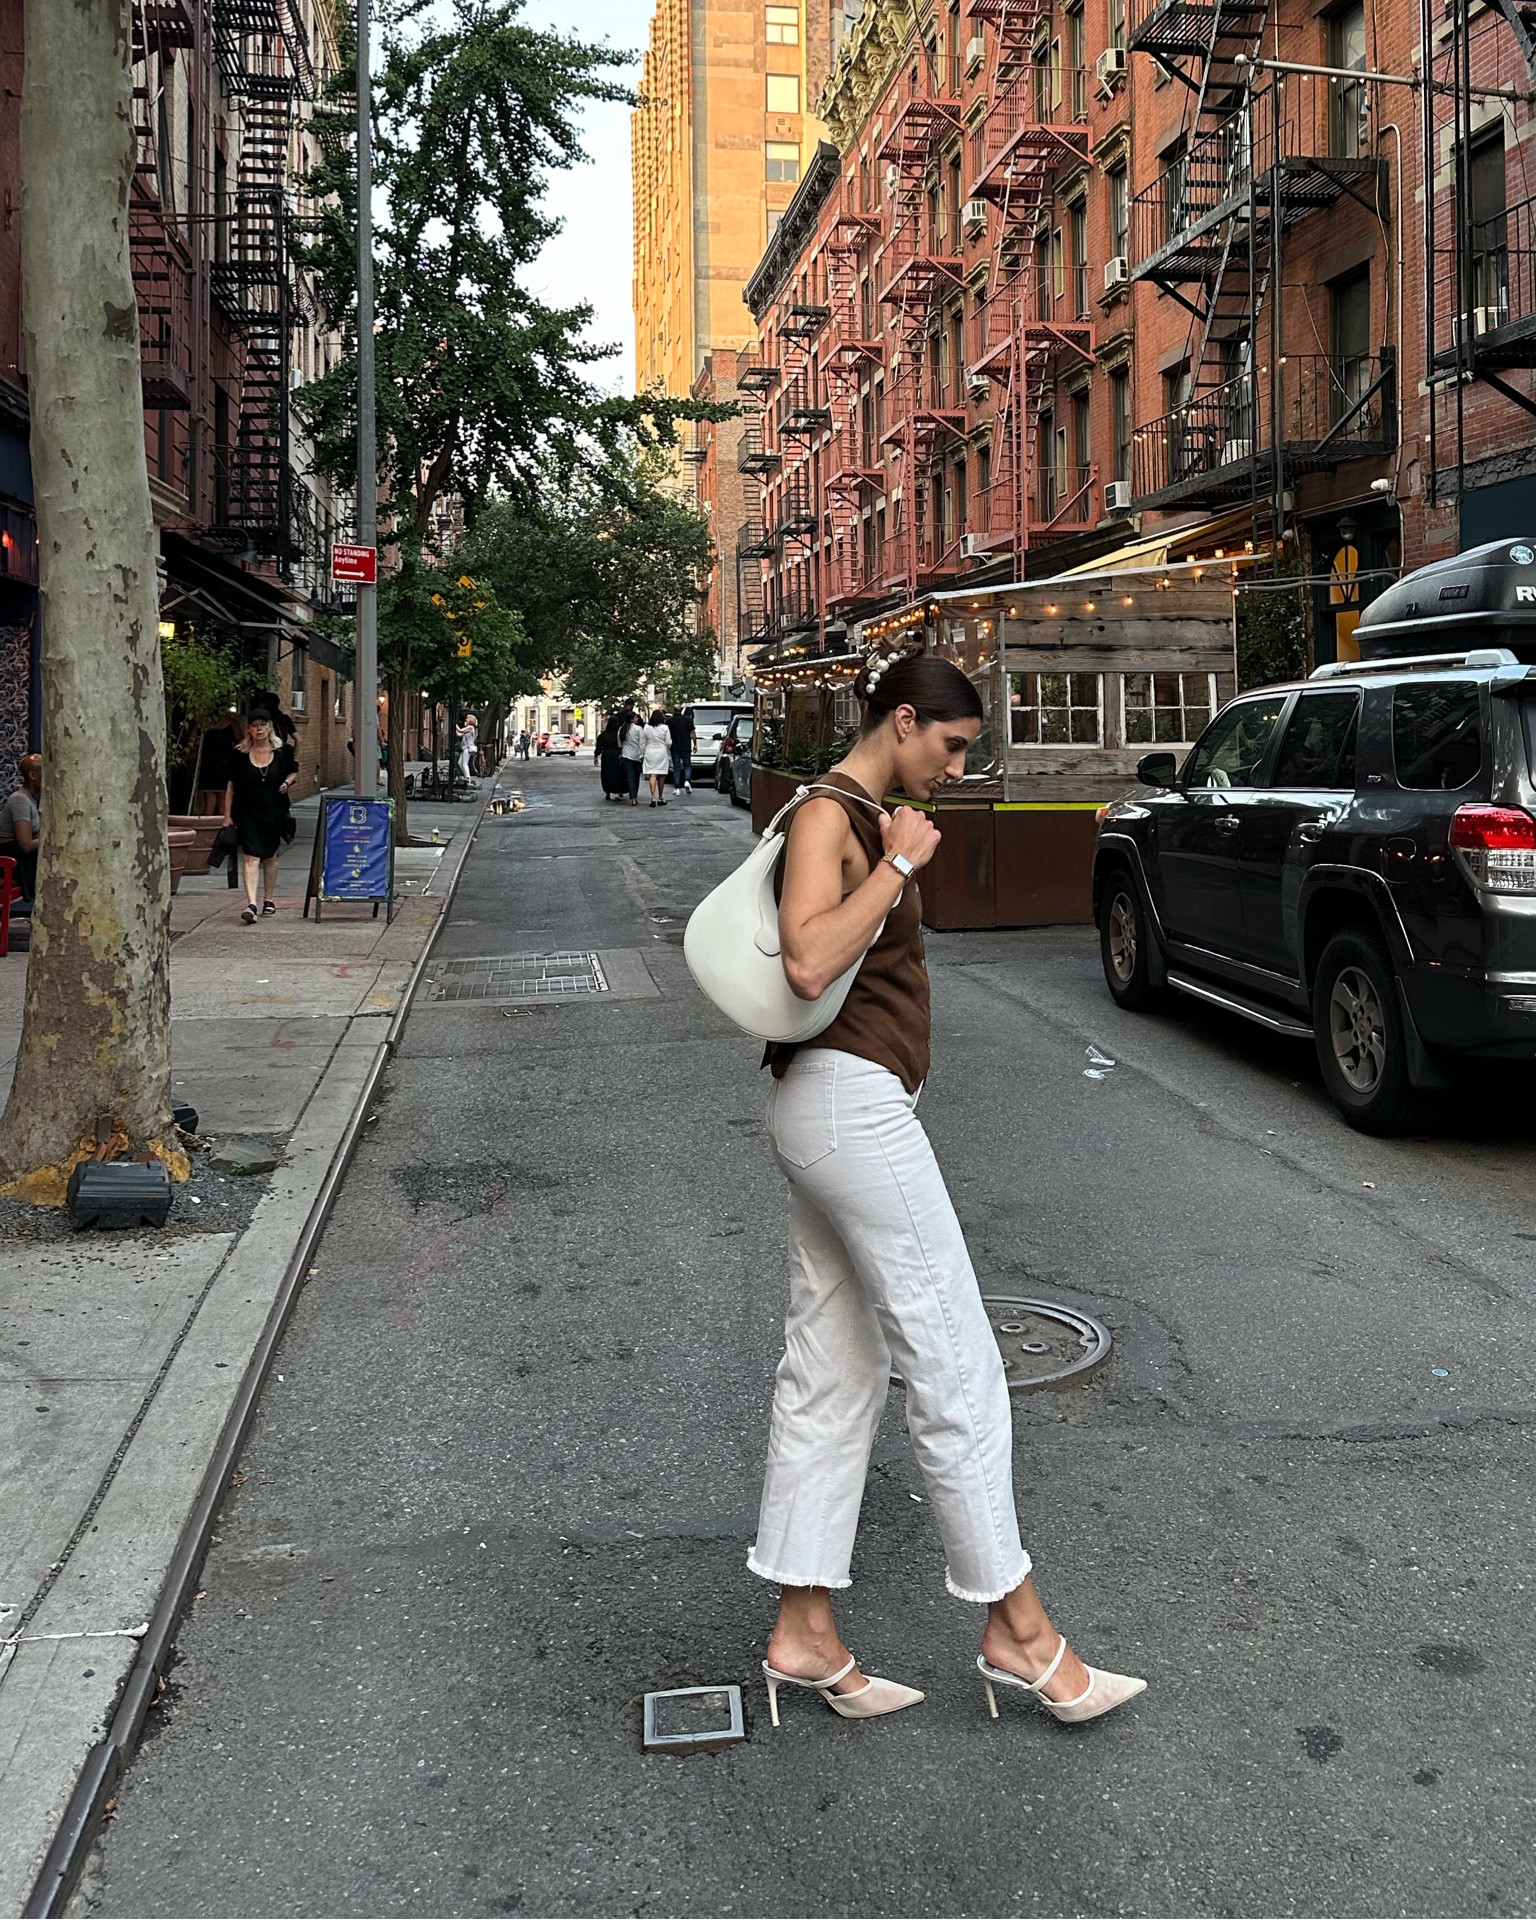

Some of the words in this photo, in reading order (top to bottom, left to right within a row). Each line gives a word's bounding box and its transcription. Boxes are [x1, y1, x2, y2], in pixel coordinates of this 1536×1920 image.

[344, 548, 370, 558] STANDING
[334, 556, 357, 564] Anytime
[349, 805, 367, 824] B
